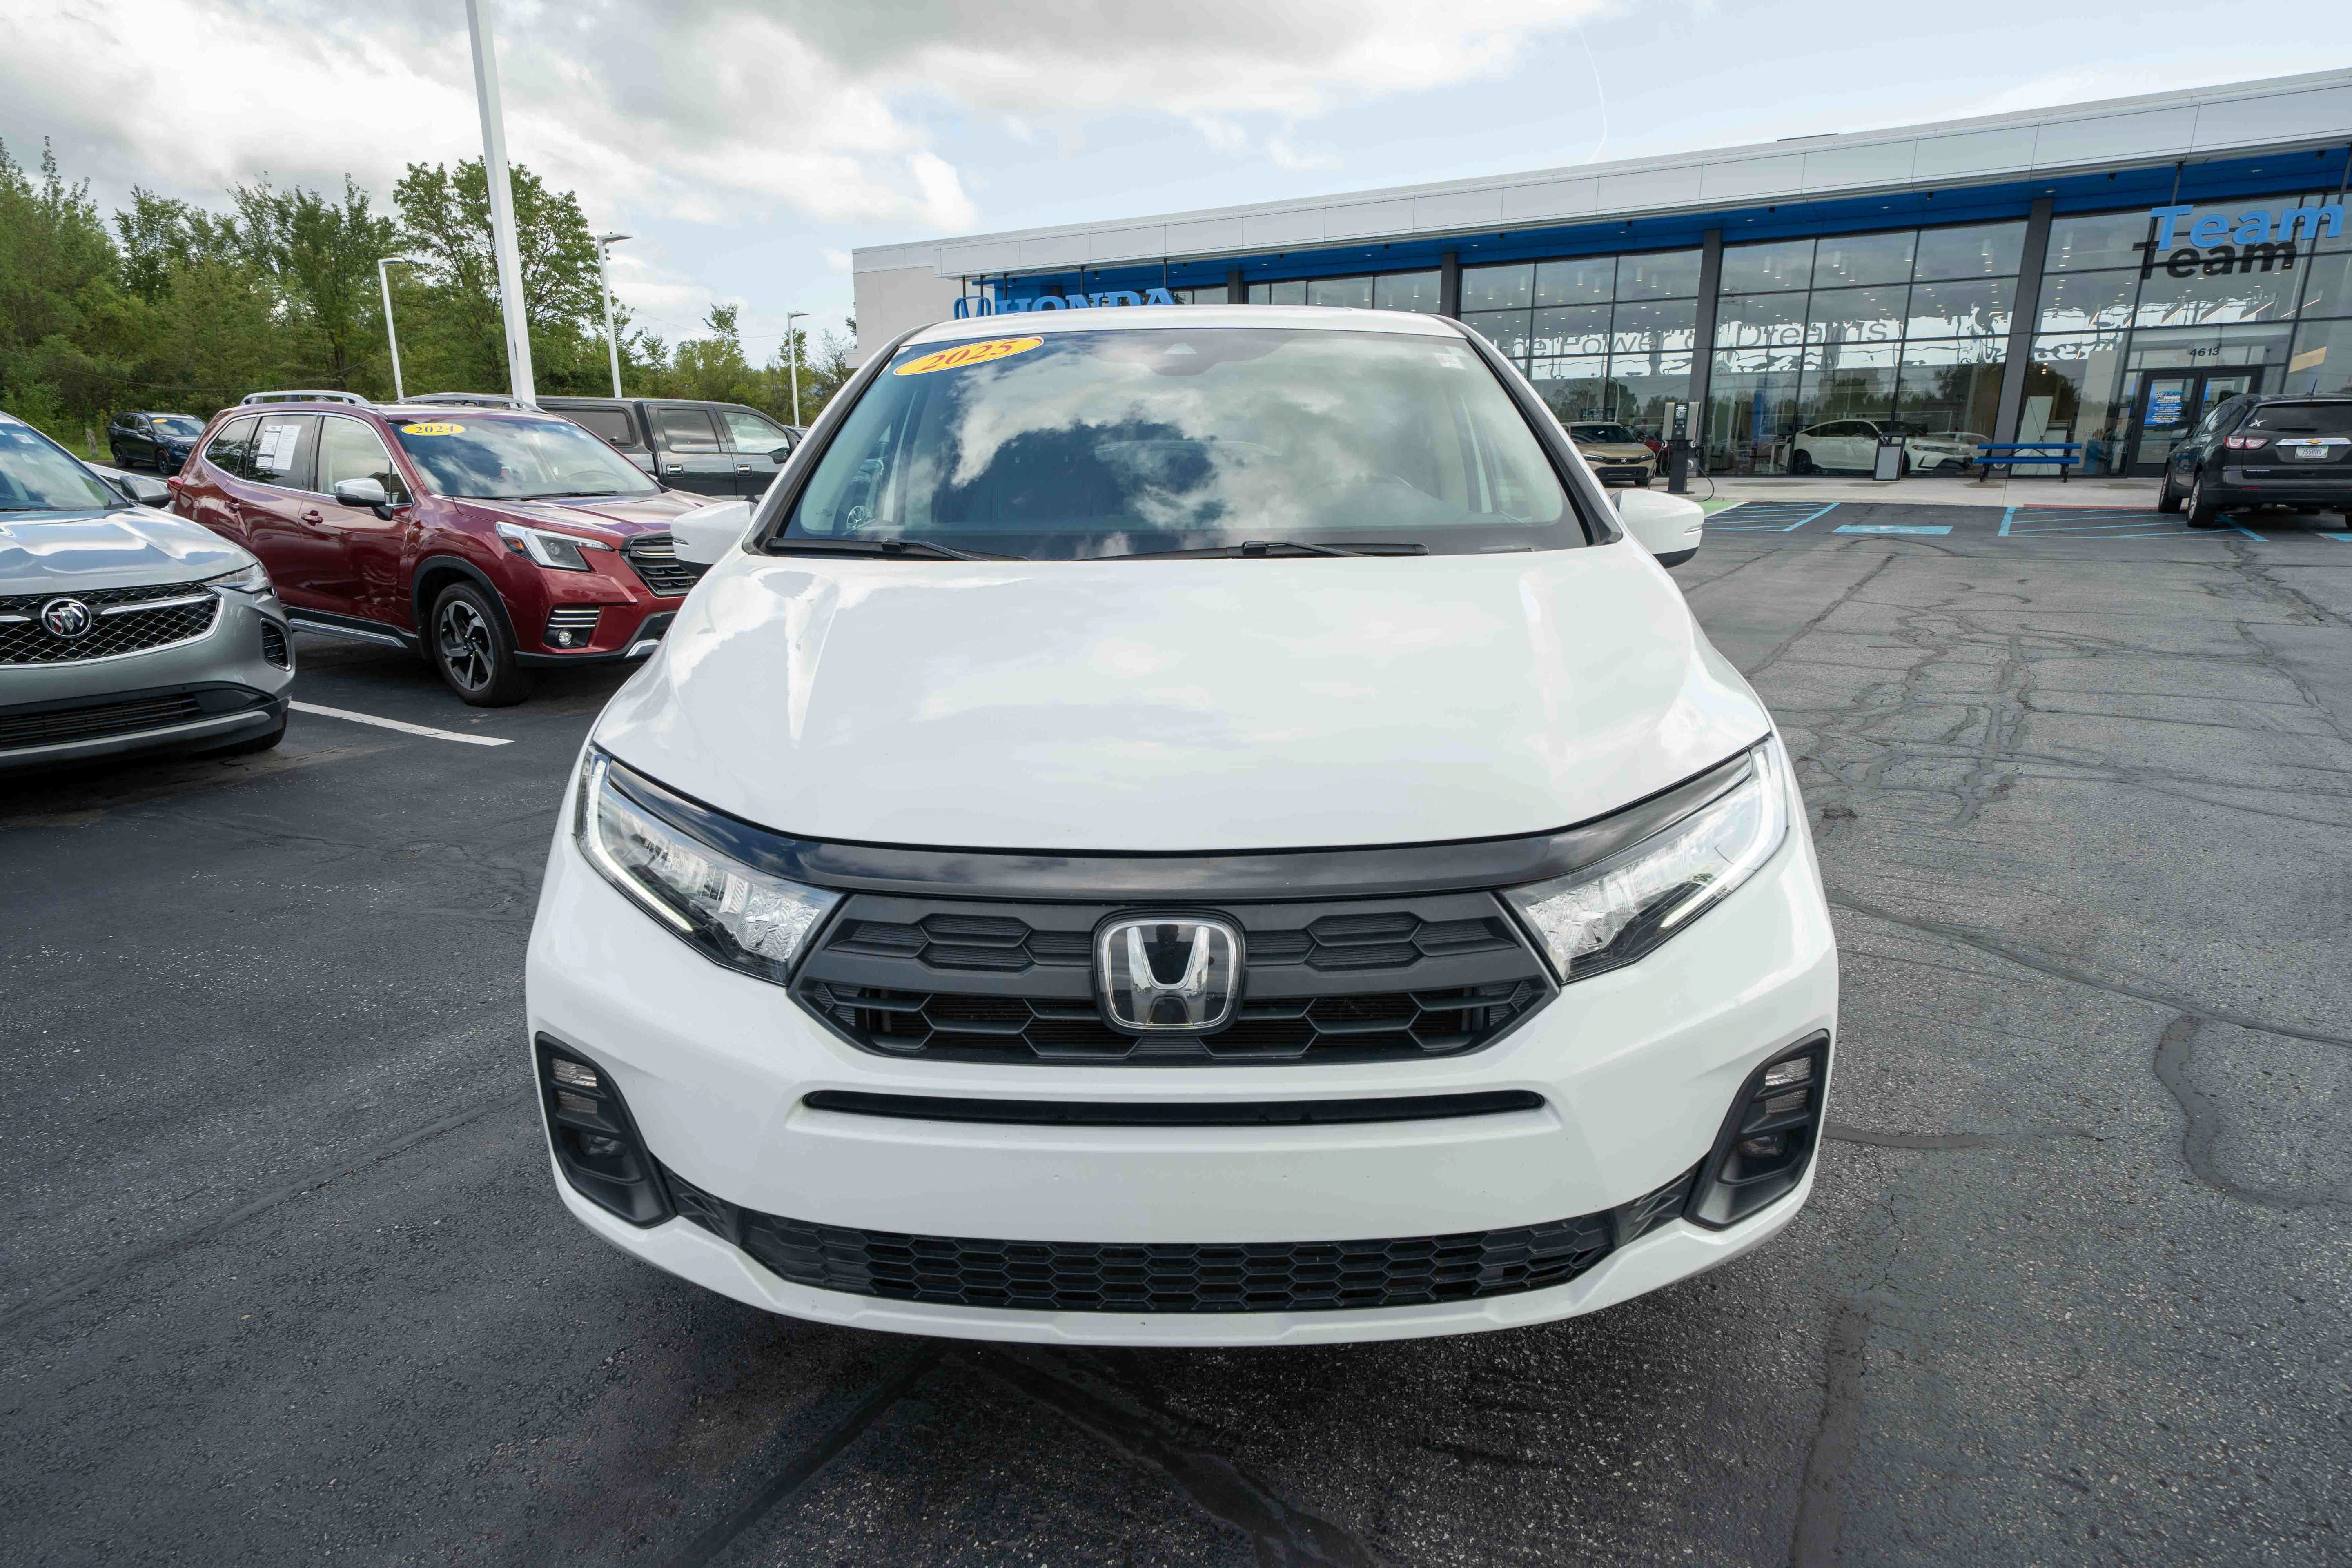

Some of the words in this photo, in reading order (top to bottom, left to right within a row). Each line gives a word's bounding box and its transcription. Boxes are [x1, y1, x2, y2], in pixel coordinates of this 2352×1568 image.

[2150, 204, 2345, 252] Team
[995, 287, 1176, 316] HONDA
[1559, 331, 1672, 355] Power
[1736, 321, 1887, 347] Dreams
[2189, 347, 2220, 356] 4613
[919, 340, 1019, 371] 2025
[414, 425, 454, 434] 2024
